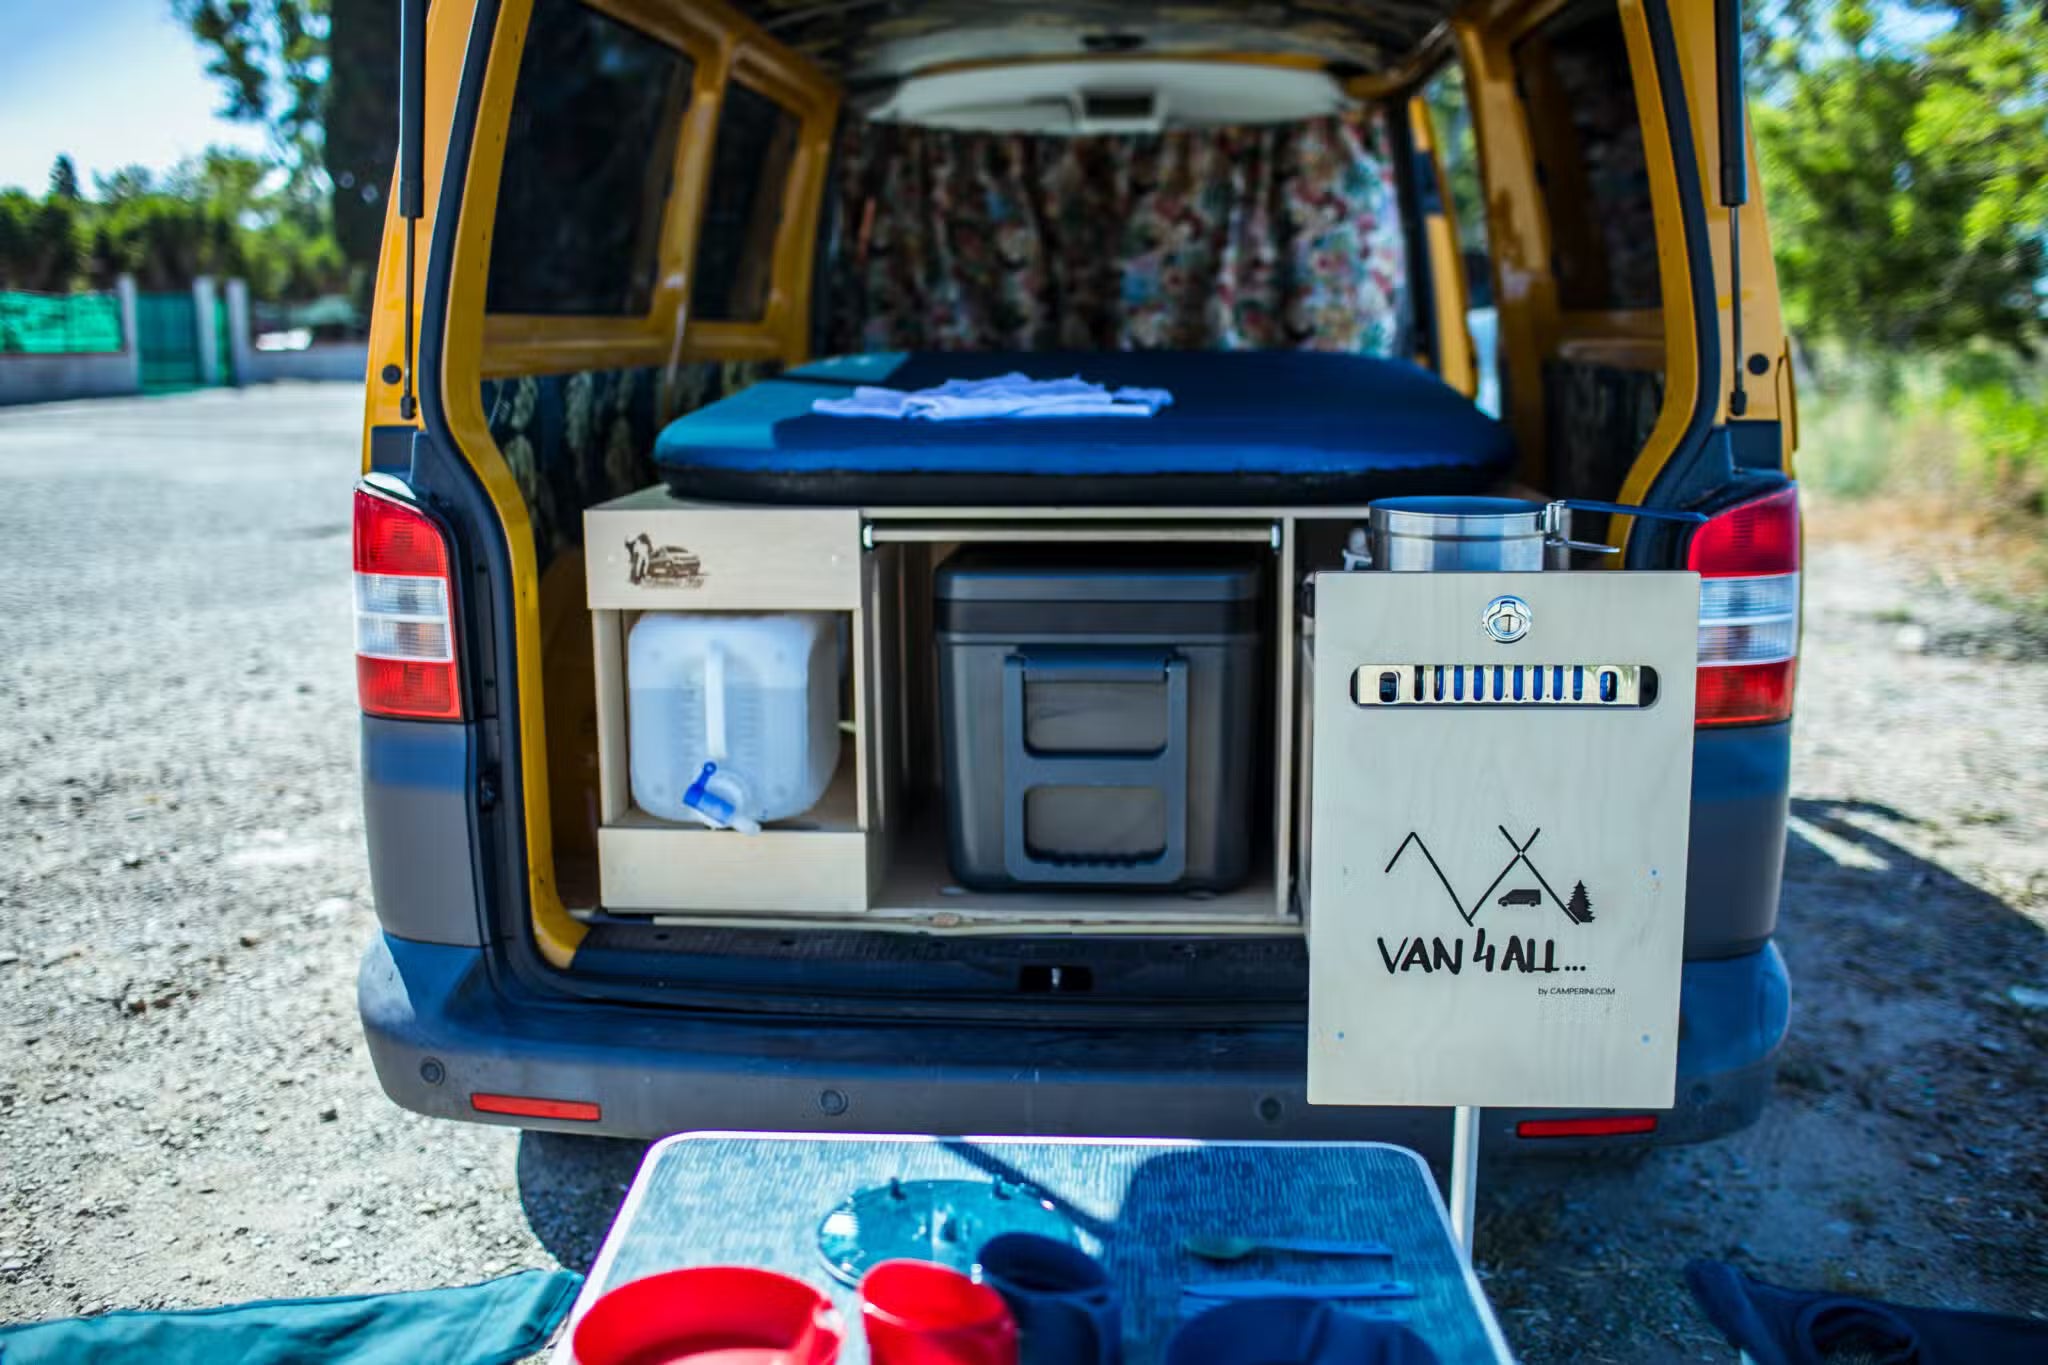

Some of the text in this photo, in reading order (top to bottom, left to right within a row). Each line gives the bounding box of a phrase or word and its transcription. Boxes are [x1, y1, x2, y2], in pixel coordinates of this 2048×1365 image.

[1377, 936, 1463, 975] VAN
[1473, 927, 1496, 973] 4
[1538, 987, 1548, 997] by
